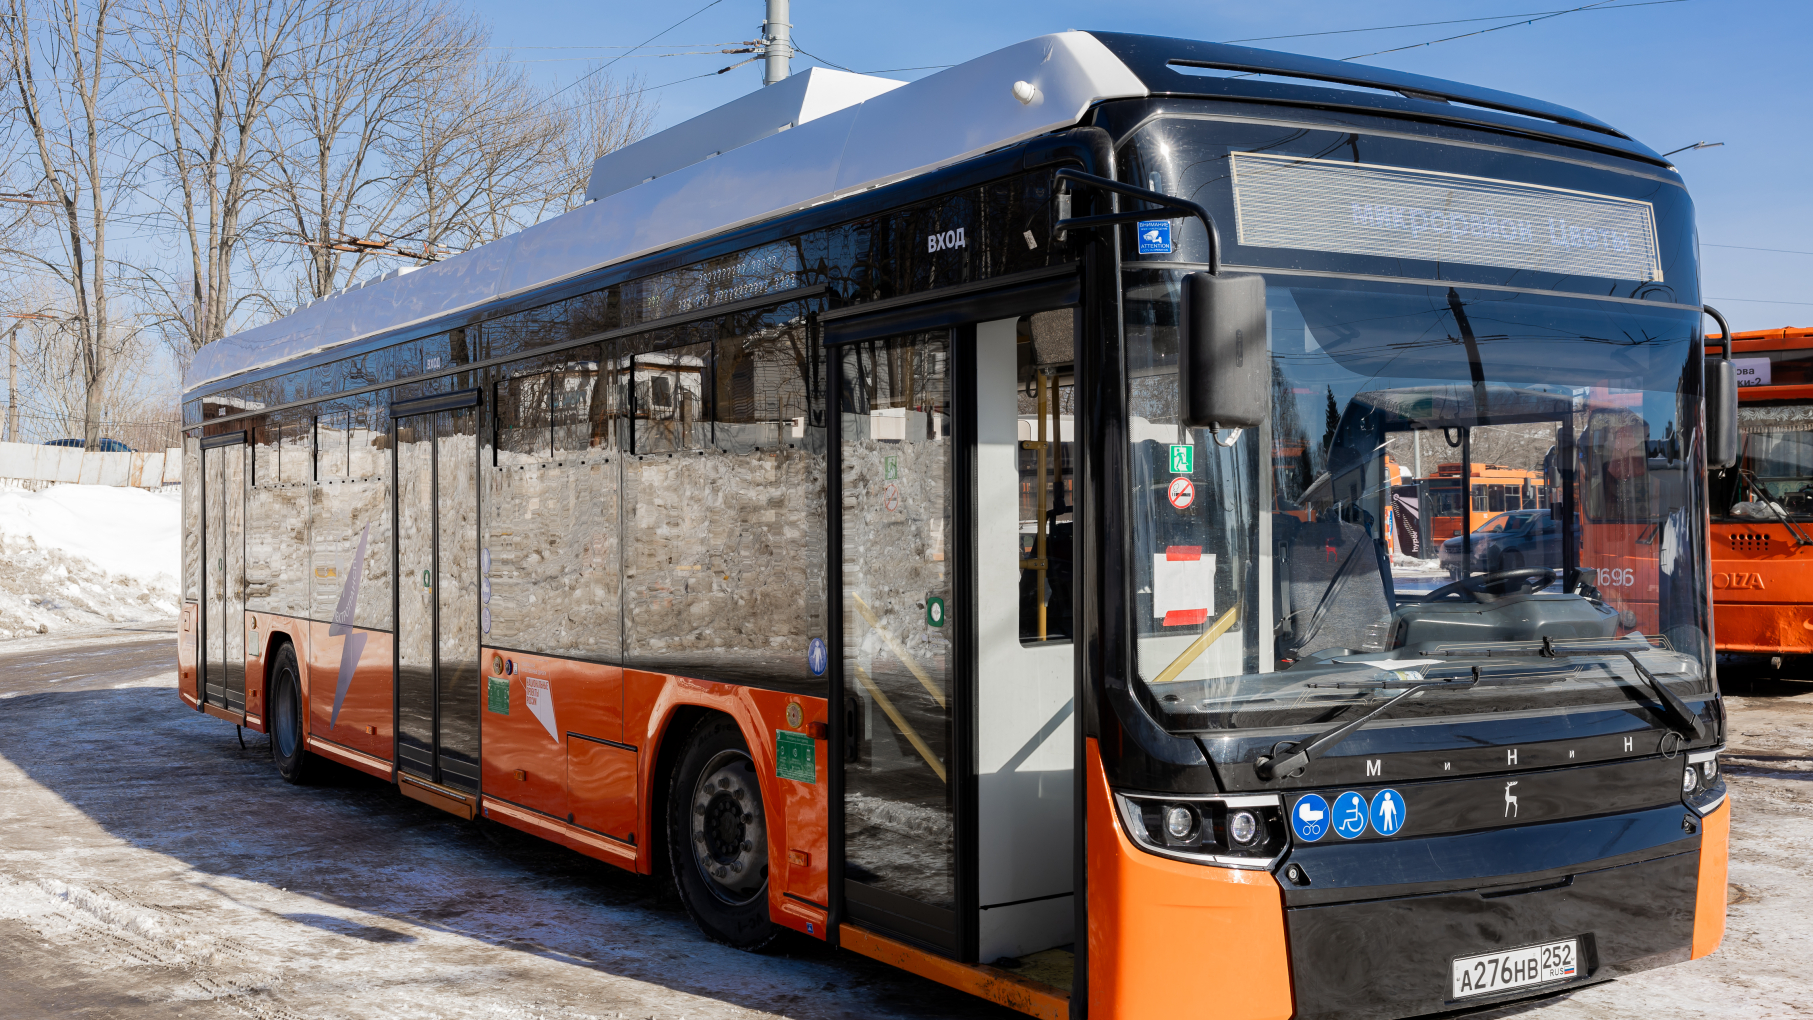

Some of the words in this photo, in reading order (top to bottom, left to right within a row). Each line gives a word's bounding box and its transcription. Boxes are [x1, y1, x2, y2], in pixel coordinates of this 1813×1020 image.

[927, 227, 966, 253] ВХОД
[1596, 567, 1635, 587] 1696
[1542, 944, 1572, 970] 252
[1549, 968, 1564, 977] RUS
